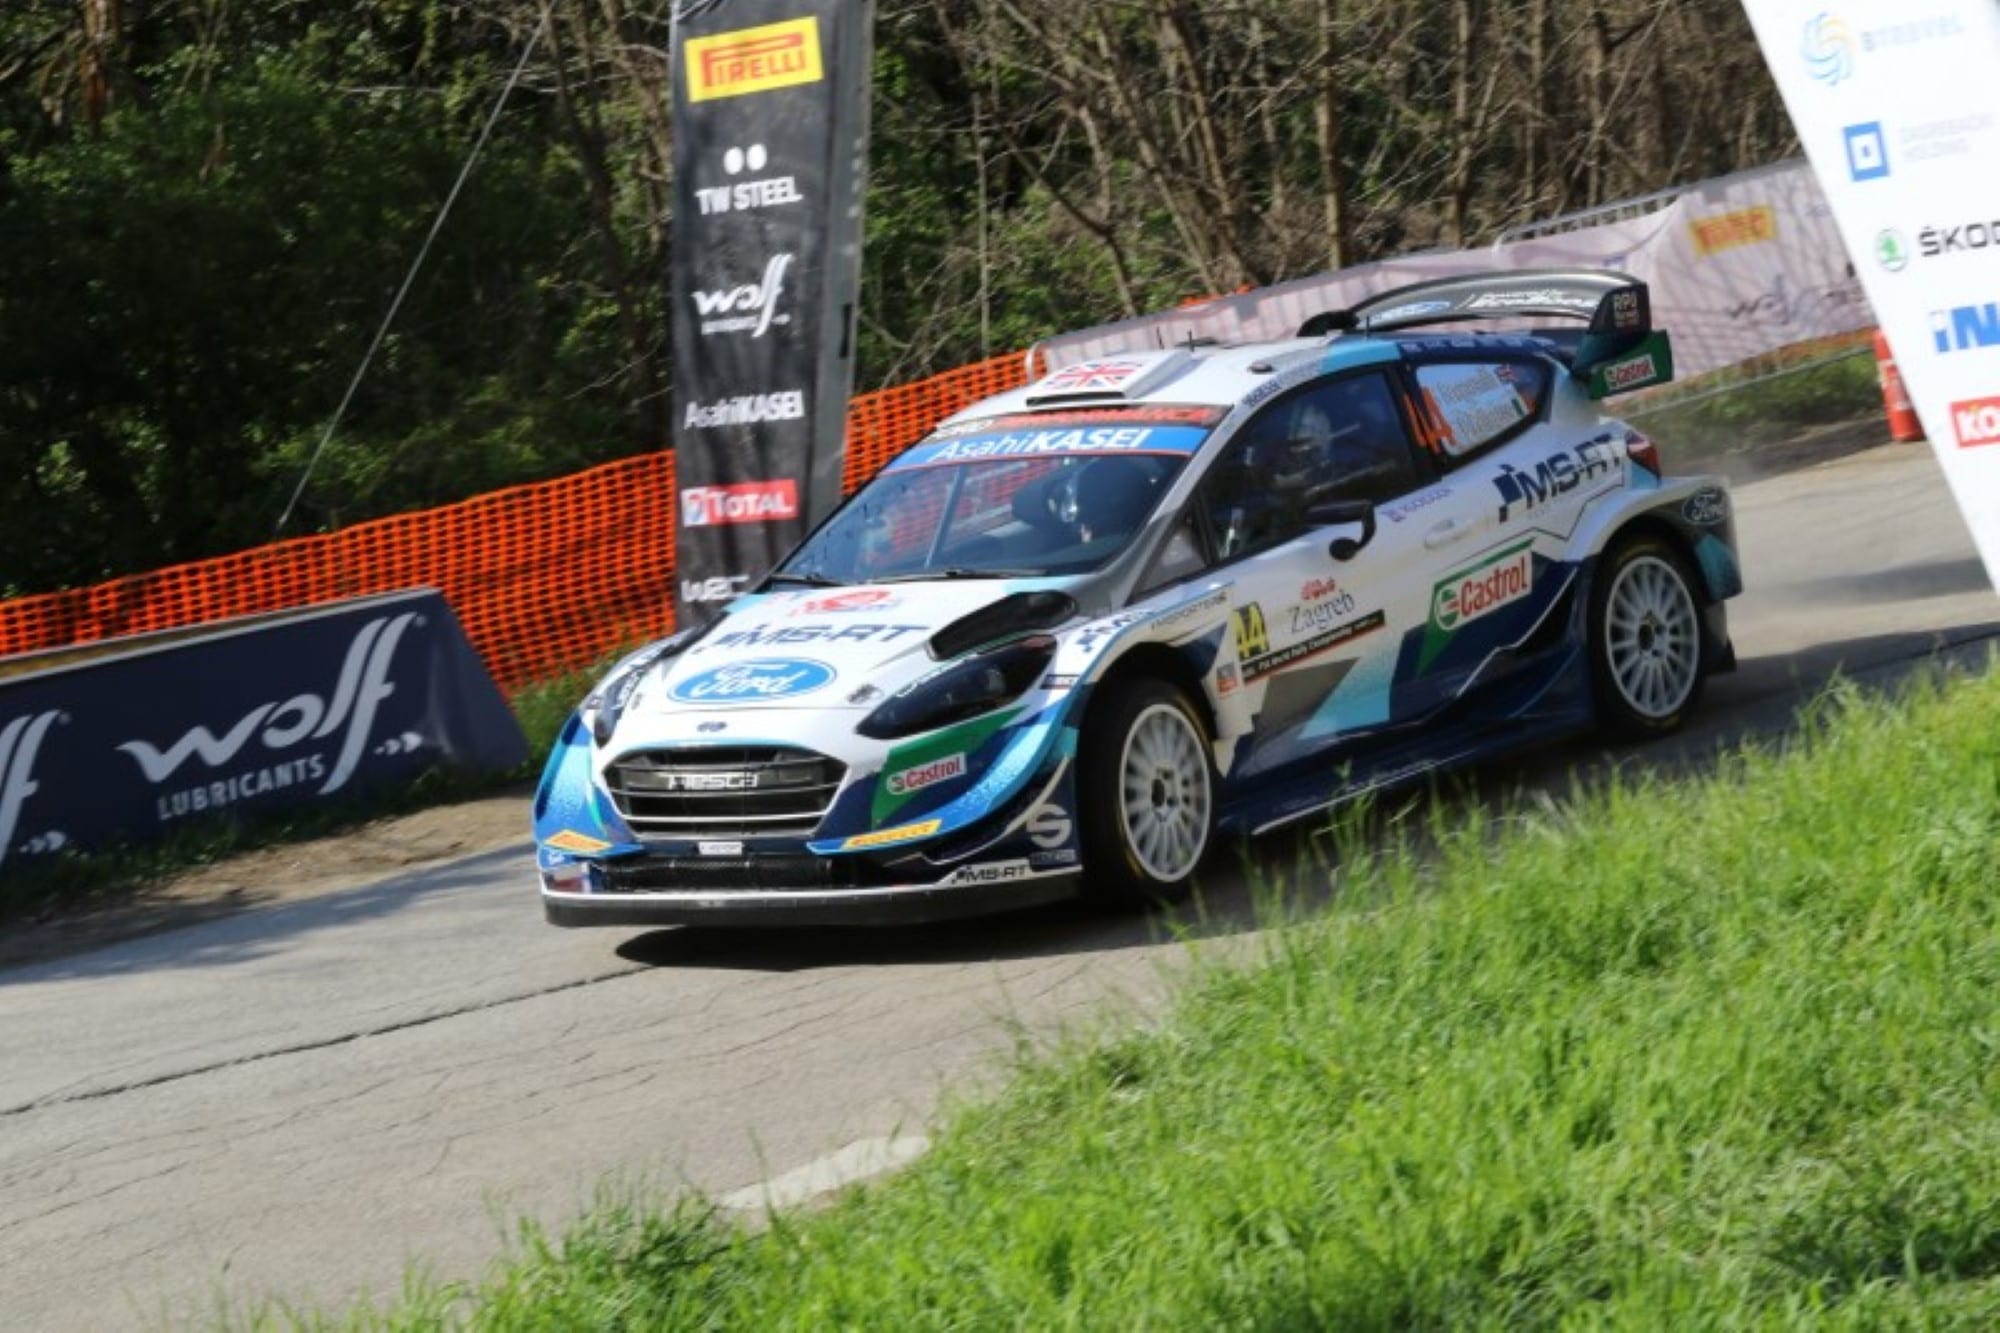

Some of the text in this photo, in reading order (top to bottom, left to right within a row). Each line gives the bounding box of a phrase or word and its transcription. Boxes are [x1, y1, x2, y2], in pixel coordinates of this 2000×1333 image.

[700, 32, 806, 87] PIRELLI
[695, 176, 803, 215] TW STEEL
[689, 254, 795, 337] wolf
[927, 427, 1154, 462] AsahiKASEI
[708, 491, 794, 518] TOTAL
[1461, 556, 1527, 617] Castrol
[1288, 588, 1355, 633] Zagreb
[690, 663, 808, 698] Ford
[115, 612, 418, 796] wolf
[157, 753, 326, 822] LUBRICANTS
[903, 756, 961, 789] Castrol
